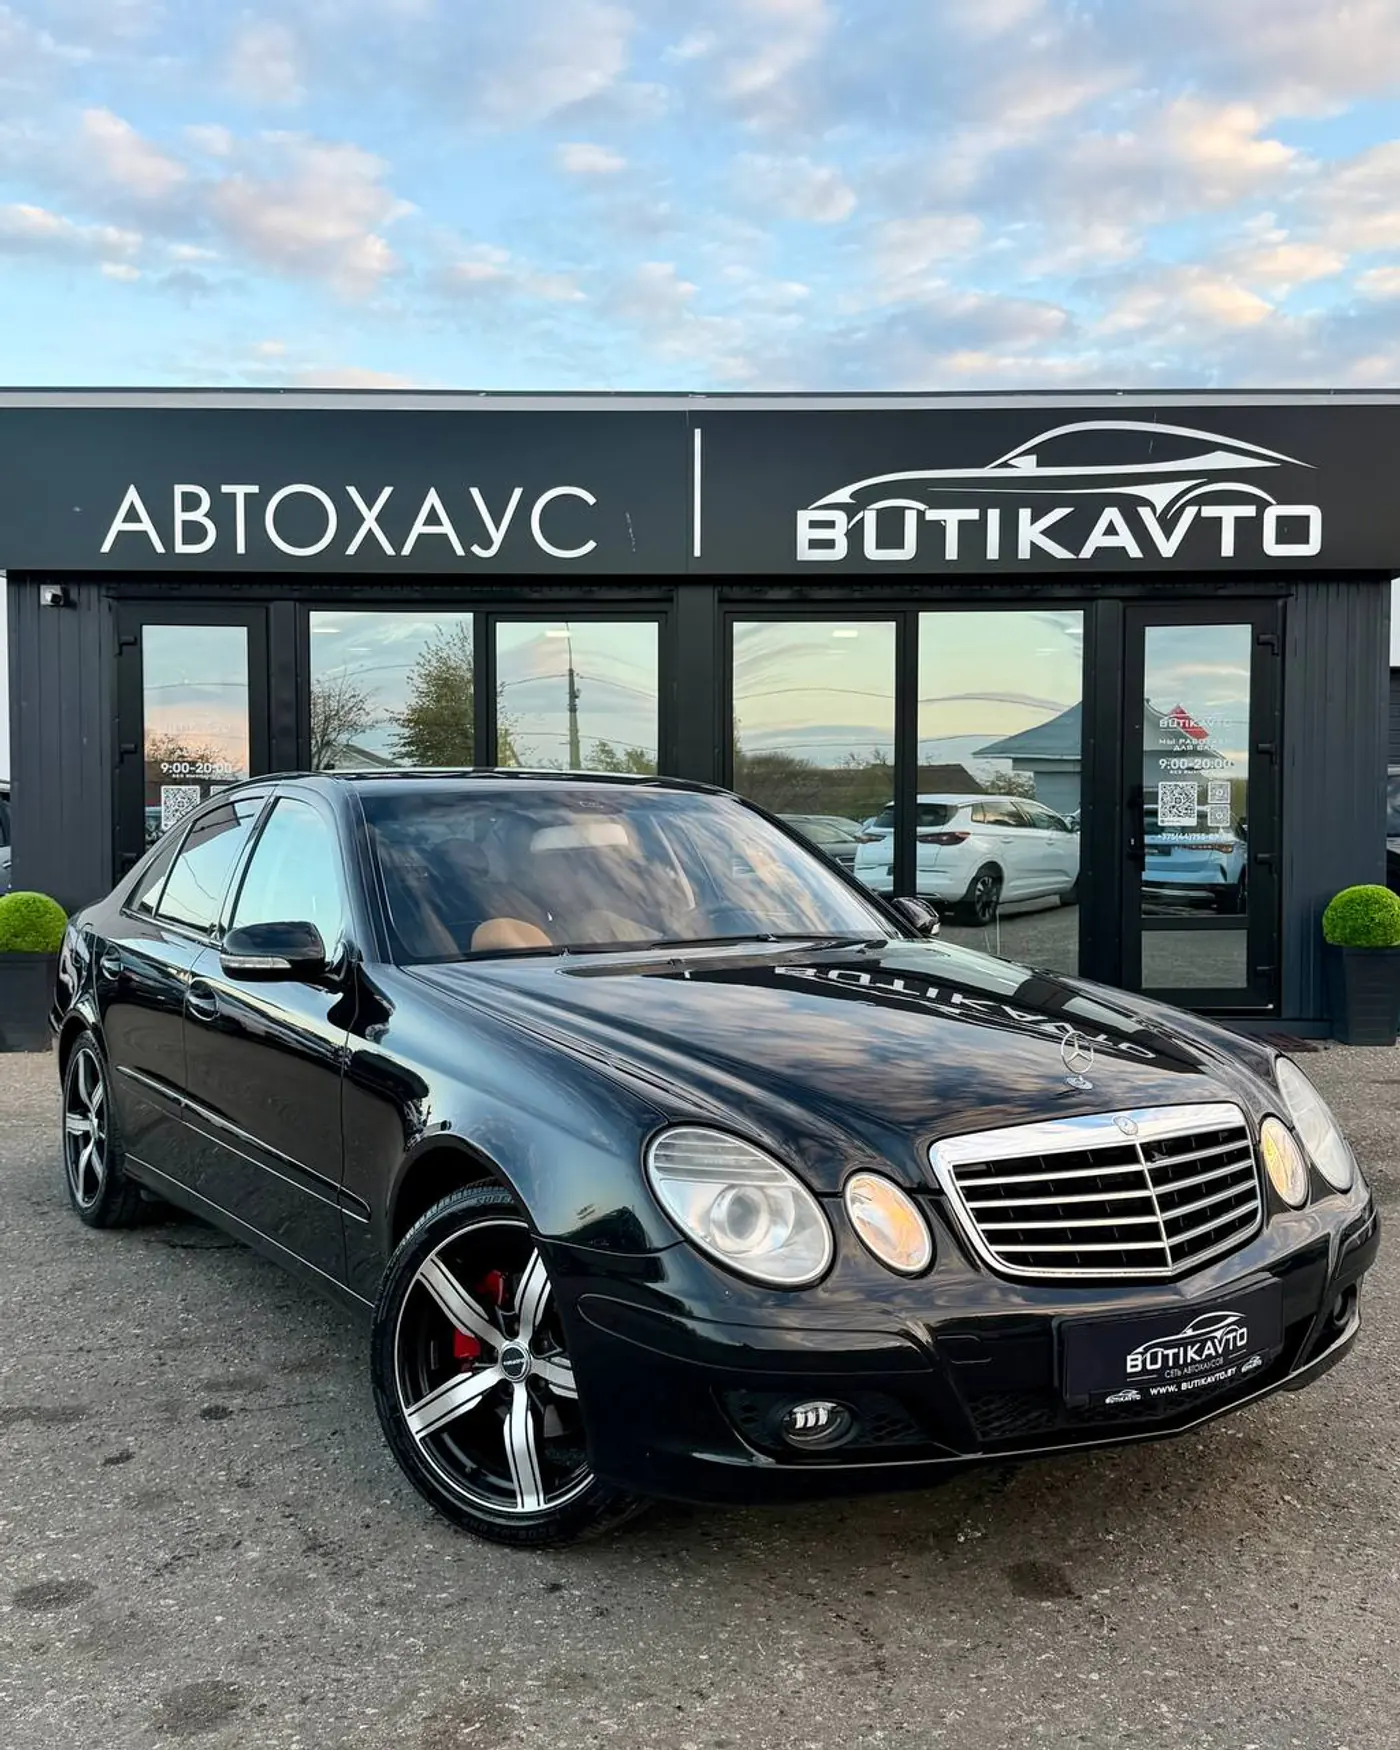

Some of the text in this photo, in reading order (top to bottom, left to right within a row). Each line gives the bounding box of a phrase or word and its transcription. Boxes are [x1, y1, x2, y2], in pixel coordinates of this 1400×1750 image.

[100, 483, 598, 559] АВТОХАУС
[796, 503, 1323, 562] BUTIKAVTO
[160, 761, 232, 773] 9:00-20:00
[1126, 1326, 1248, 1373] BUTIKAVTO
[1164, 1368, 1183, 1379] СЕТЬ
[1181, 1366, 1238, 1391] BUTIKAVTO.BY
